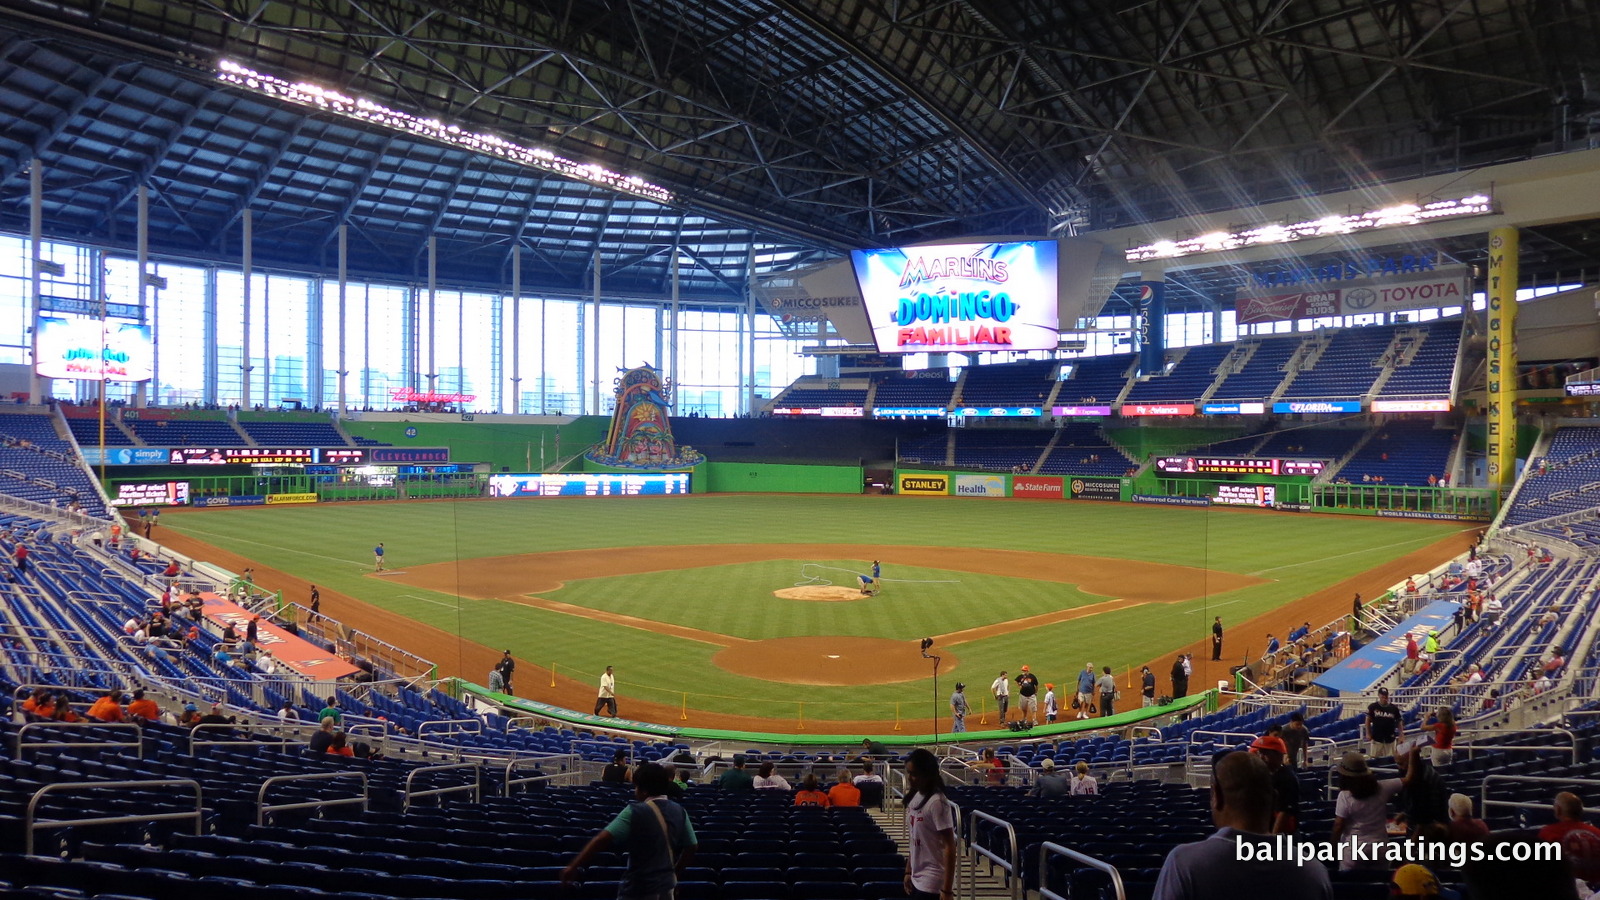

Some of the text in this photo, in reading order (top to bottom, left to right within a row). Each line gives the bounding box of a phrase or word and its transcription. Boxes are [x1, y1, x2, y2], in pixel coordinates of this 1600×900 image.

[1366, 252, 1435, 279] PARK
[899, 256, 1009, 287] MARLINS
[1305, 293, 1336, 303] GRAB
[1380, 282, 1459, 303] TOYOTA
[783, 296, 860, 310] MICCOSUKEE
[1305, 306, 1335, 316] BUDS
[792, 312, 828, 325] pepsi
[1140, 307, 1151, 345] pepsi
[897, 325, 1013, 346] FAMILIAR
[124, 411, 139, 419] 401
[405, 428, 416, 436] 42
[135, 450, 162, 459] simply
[372, 450, 447, 461] CLEVELANDER
[905, 480, 943, 489] STANLEY
[958, 485, 986, 494] Health
